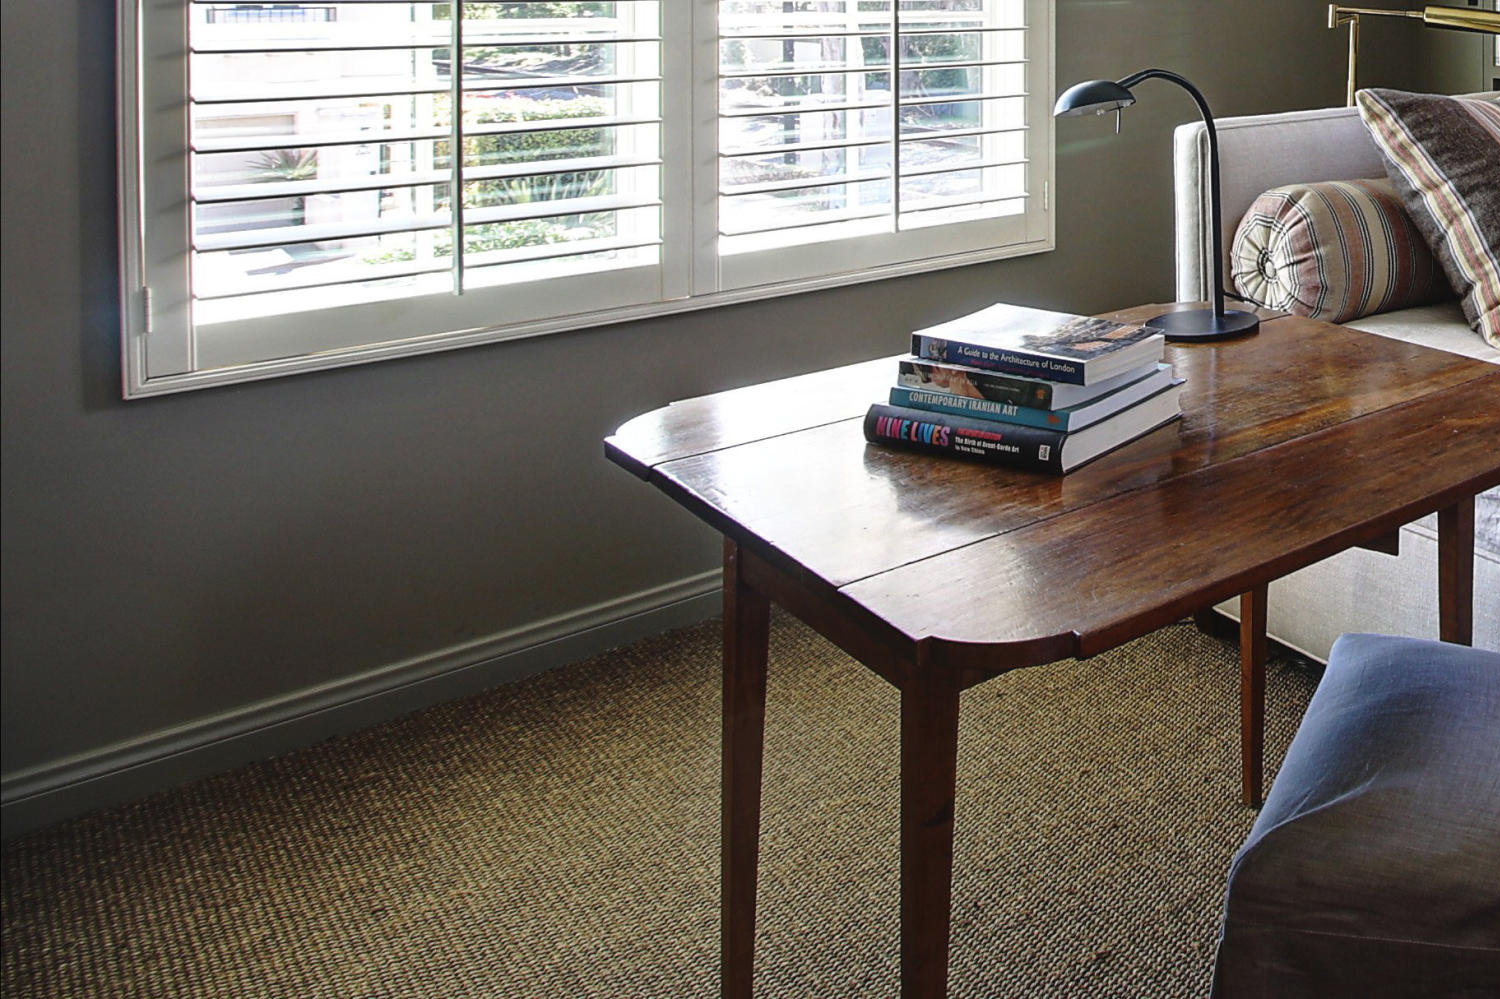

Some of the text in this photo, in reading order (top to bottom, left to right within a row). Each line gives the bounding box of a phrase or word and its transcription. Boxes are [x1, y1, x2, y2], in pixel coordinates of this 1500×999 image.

[963, 347, 981, 358] Guide
[1000, 354, 1040, 368] Architecture
[1050, 362, 1076, 374] London
[909, 391, 1018, 417] CONTEMPORARY IRANIAN ART
[876, 415, 909, 441] NINE
[911, 420, 951, 447] LIVES
